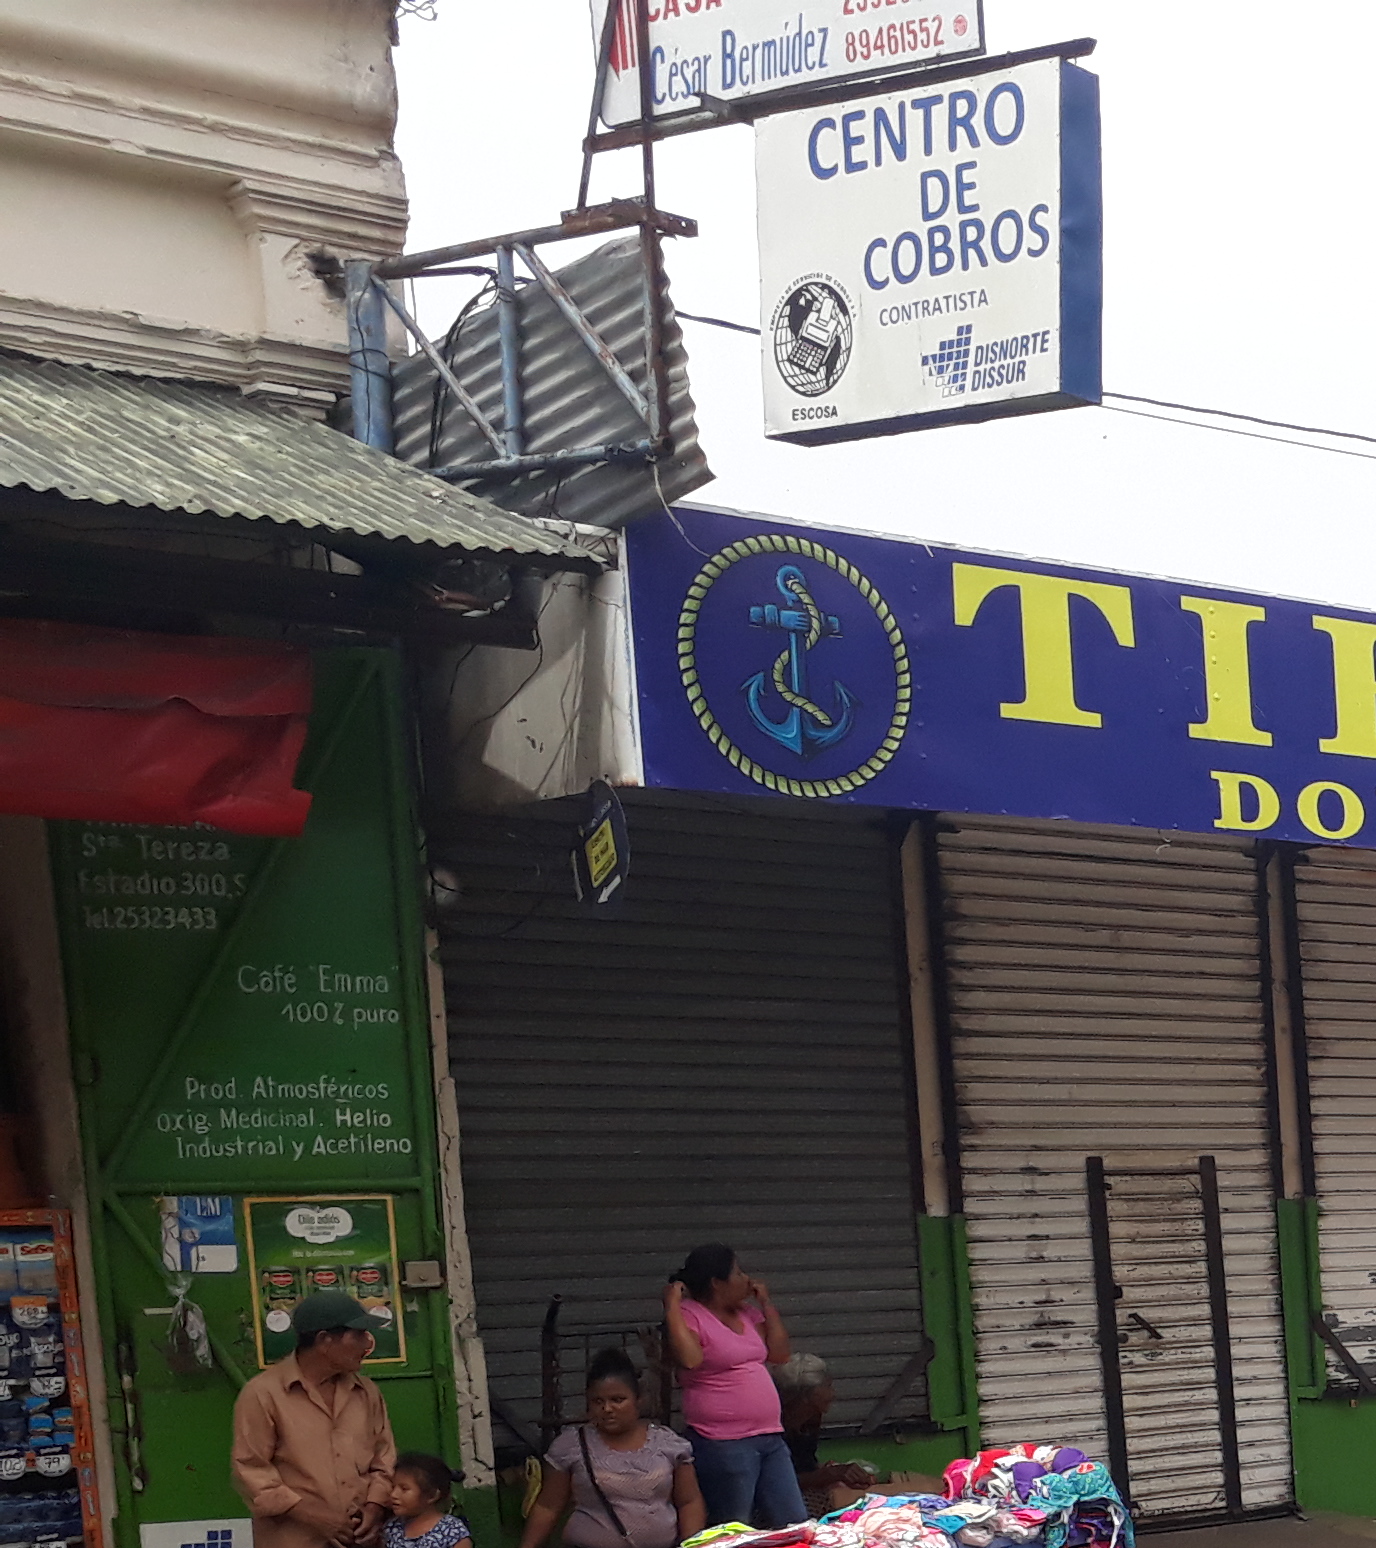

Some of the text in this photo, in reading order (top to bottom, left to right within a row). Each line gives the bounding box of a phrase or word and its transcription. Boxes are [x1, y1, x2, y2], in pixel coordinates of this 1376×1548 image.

[651, 13, 945, 105] César Bermúdez 89461552
[808, 82, 1025, 180] CENTRO
[920, 161, 980, 223] DE
[864, 203, 1051, 291] COBROS
[879, 288, 989, 327] CONTRATISTA
[973, 329, 1050, 369] DISNORTE
[970, 363, 1027, 392] DISSUR
[791, 405, 838, 421] ESCOSA
[135, 833, 231, 861] Tereza
[77, 868, 177, 895] Estadio
[238, 965, 298, 995] Café
[281, 1002, 399, 1030] 100% puro
[185, 1075, 389, 1103] Prod. Atmosféricos
[336, 1108, 392, 1128] Helio
[175, 1136, 412, 1162] Industrial y Acetileno
